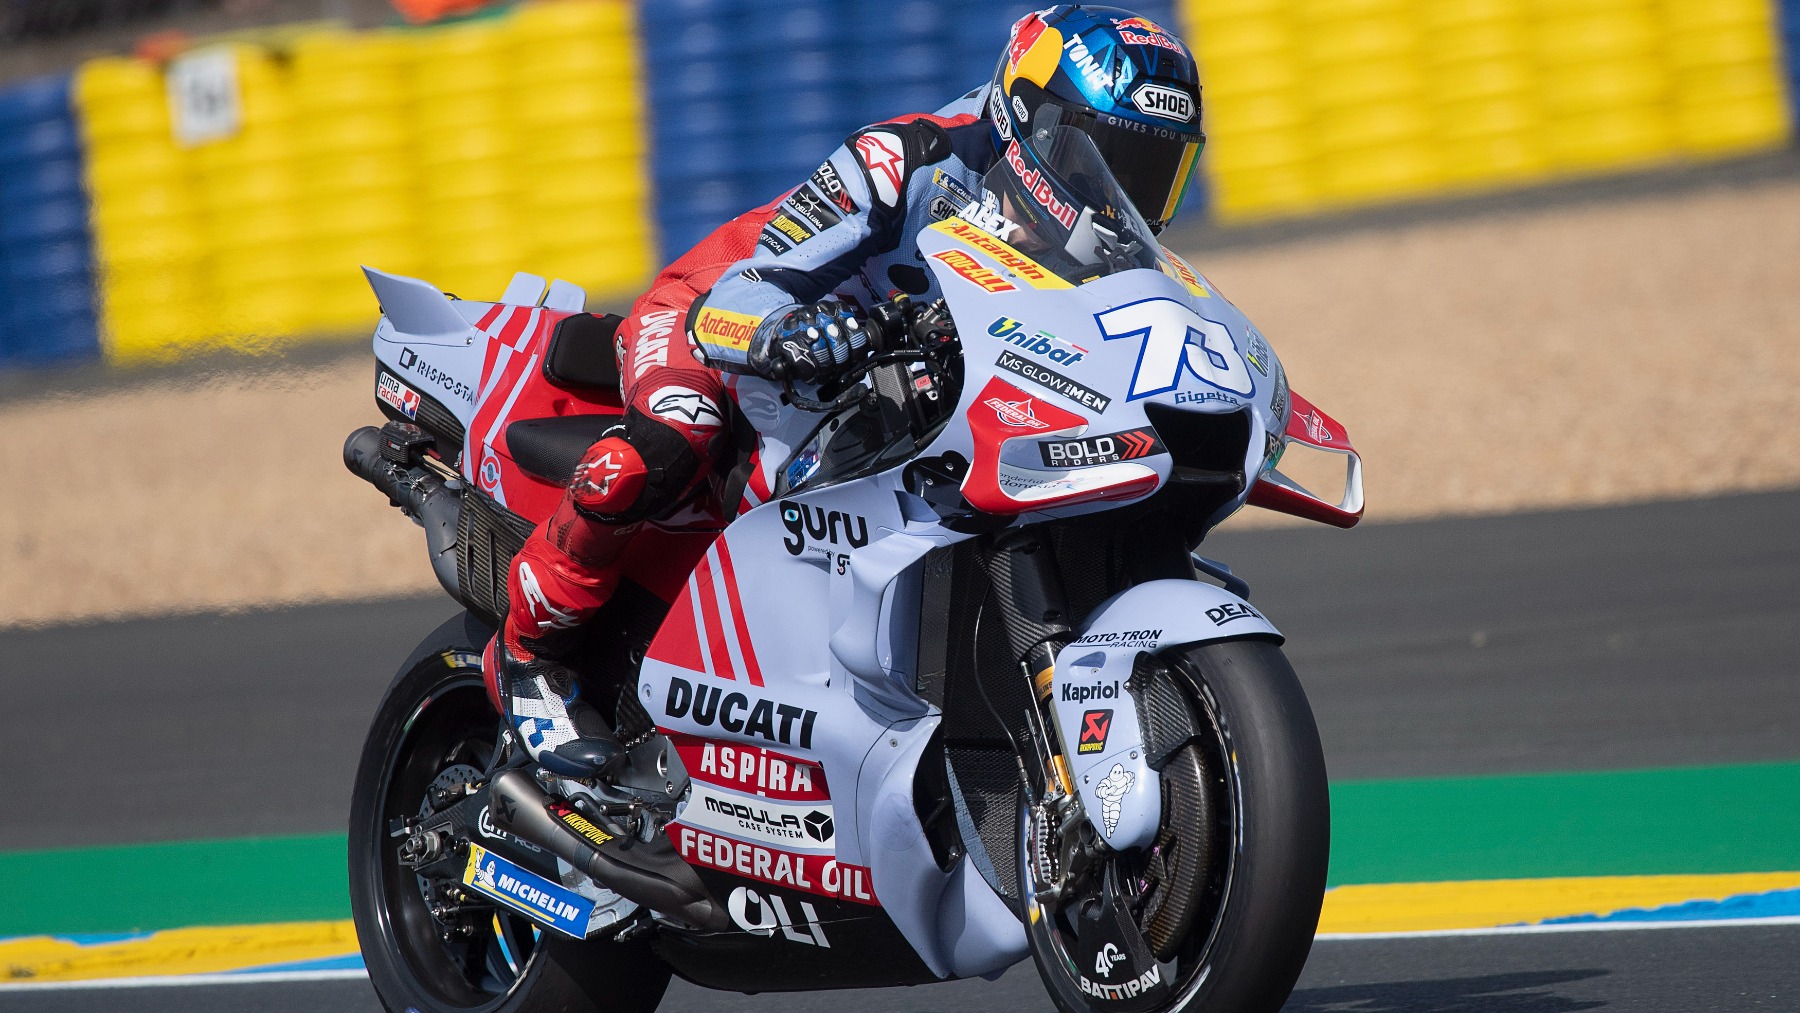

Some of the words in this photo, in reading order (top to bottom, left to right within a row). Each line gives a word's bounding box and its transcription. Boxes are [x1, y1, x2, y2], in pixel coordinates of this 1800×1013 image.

[1013, 99, 1027, 120] SHOEI
[1145, 91, 1188, 116] SHOEI
[1108, 117, 1147, 133] GIVES
[1154, 127, 1176, 140] YOU
[944, 224, 1045, 280] Antangin
[634, 310, 678, 379] DUCATI
[987, 316, 1085, 367] Unibat
[999, 352, 1023, 371] MS
[1022, 365, 1067, 389] GLOW
[380, 373, 400, 393] uma
[377, 386, 402, 409] racing
[1175, 391, 1241, 406] Gigetta
[991, 401, 1028, 424] FEDERAL
[1048, 438, 1115, 460] BOLD
[1052, 454, 1120, 466] RIDERS
[999, 472, 1043, 484] onderful
[780, 500, 869, 555] guru
[1109, 641, 1157, 649] RACING
[1062, 681, 1119, 704] Kapriol
[665, 677, 818, 750] DUCATI
[704, 797, 801, 829] MODULA
[738, 820, 762, 832] CASE
[766, 825, 804, 839] SYSTEM
[680, 829, 810, 889] FEDERAL
[822, 860, 870, 900] OIL
[498, 874, 580, 922] MICHELIN
[1110, 954, 1127, 962] YEARS
[1080, 964, 1161, 1000] BATTIPAV
